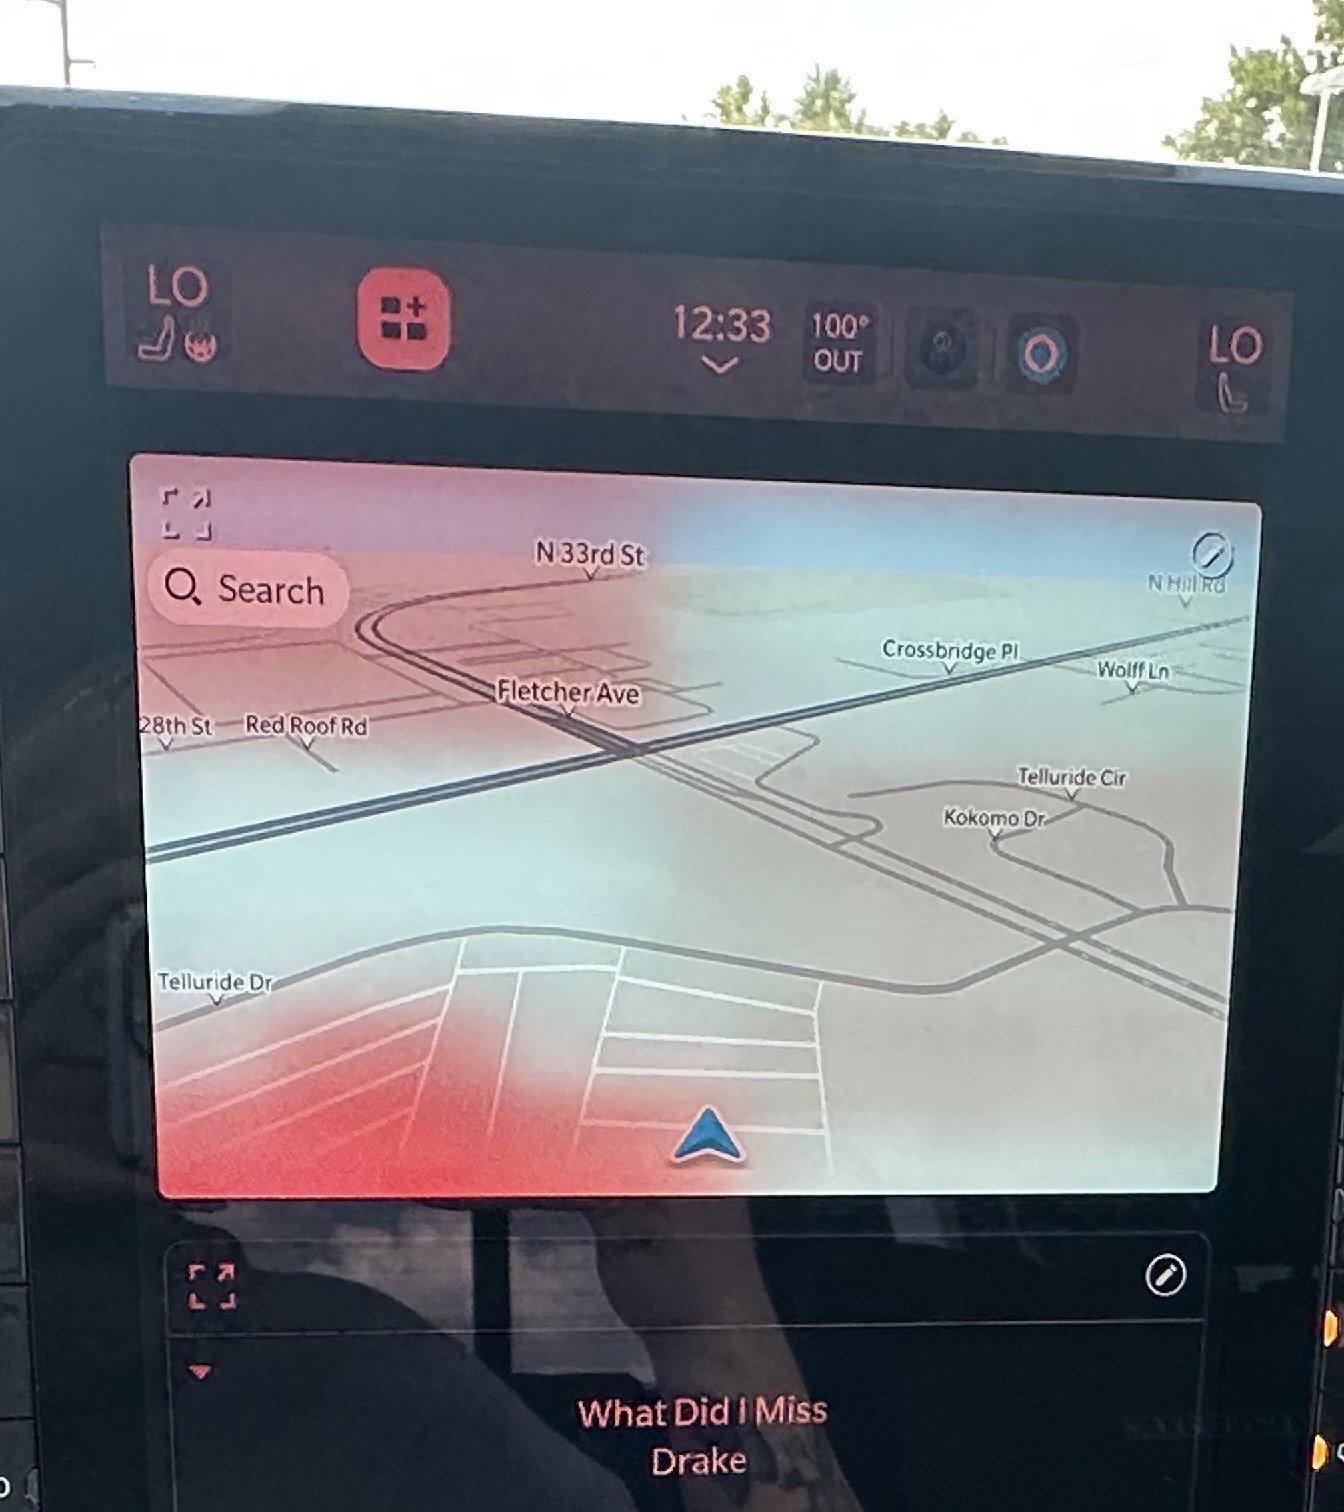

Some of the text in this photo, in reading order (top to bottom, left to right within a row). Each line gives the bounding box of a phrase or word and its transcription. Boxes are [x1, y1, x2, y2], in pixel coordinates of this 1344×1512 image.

[148, 263, 209, 307] LO
[674, 303, 773, 345] 12:33
[812, 313, 871, 342] 100°
[1209, 324, 1263, 366] LO
[813, 348, 864, 373] OUT
[536, 541, 645, 568] N 33rd St
[218, 573, 325, 607] Search
[1148, 574, 1163, 592] N
[881, 639, 998, 663] Crossbridge
[1097, 660, 1170, 681] Wolff Ln
[497, 679, 640, 706] Fletcher Ave
[141, 716, 212, 737] 28th St
[246, 714, 367, 737] Red Roof Rd
[1018, 767, 1126, 787] Telluride Cir
[944, 808, 1045, 828] Kokomo Dr
[158, 972, 273, 992] Telluride Dr
[578, 1395, 828, 1429] What Did I Miss
[651, 1447, 747, 1477] Drake
